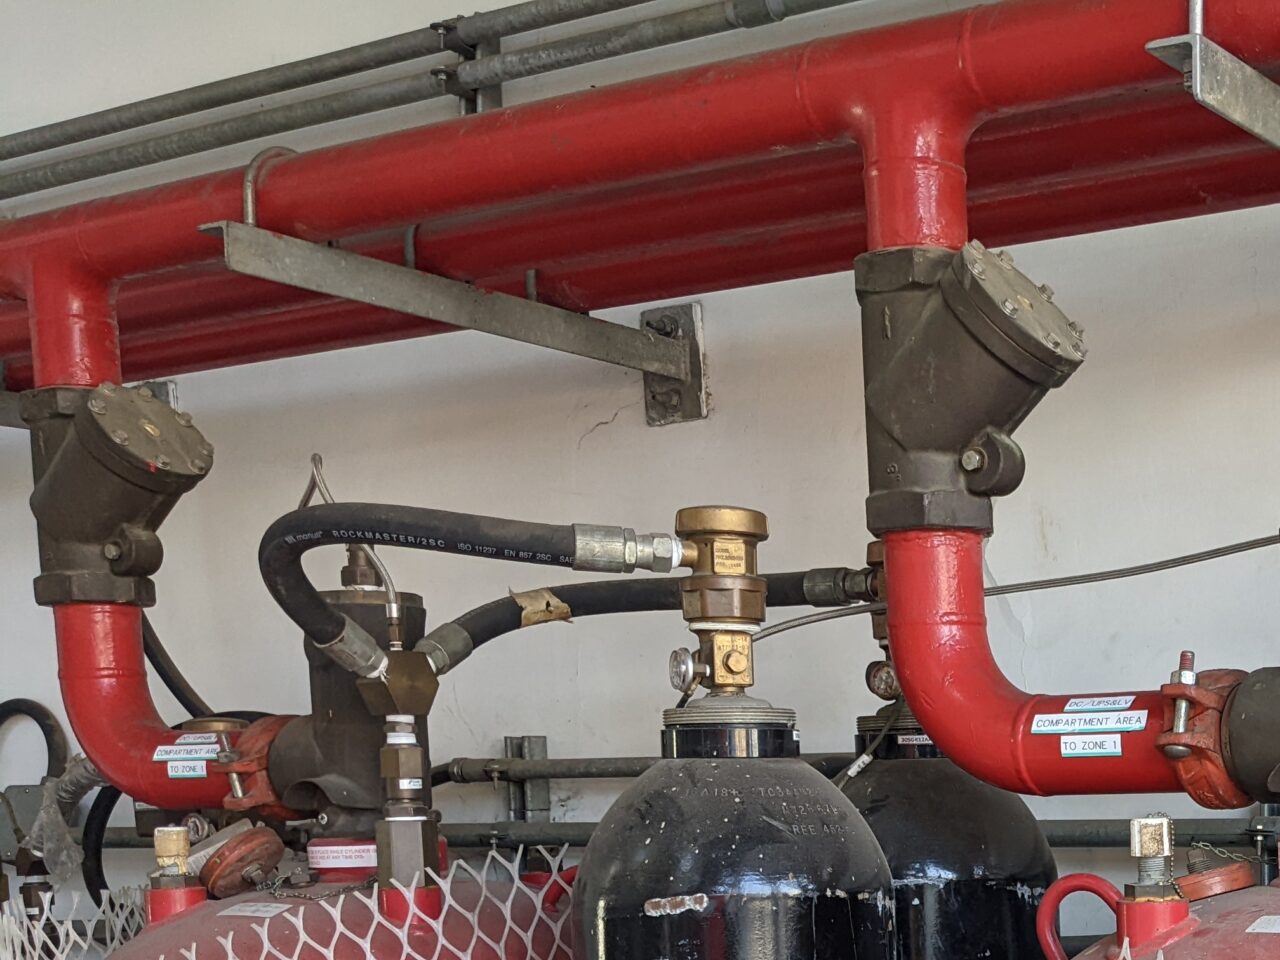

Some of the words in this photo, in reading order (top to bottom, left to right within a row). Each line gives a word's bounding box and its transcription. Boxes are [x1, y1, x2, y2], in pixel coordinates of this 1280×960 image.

[332, 530, 446, 547] ROCKMASTER/2SC
[457, 543, 472, 551] ISO
[475, 545, 497, 555] 11237
[504, 549, 516, 557] EN
[536, 553, 552, 561] 2SC
[1036, 717, 1110, 728] COMPARTMENT
[1114, 715, 1142, 725] AREA
[1063, 742, 1077, 751] TO
[1081, 741, 1108, 750] ZONE
[1112, 740, 1117, 749] 1
[156, 748, 202, 757] COMPARTMENT
[181, 765, 198, 773] ZONE
[200, 765, 204, 773] 1
